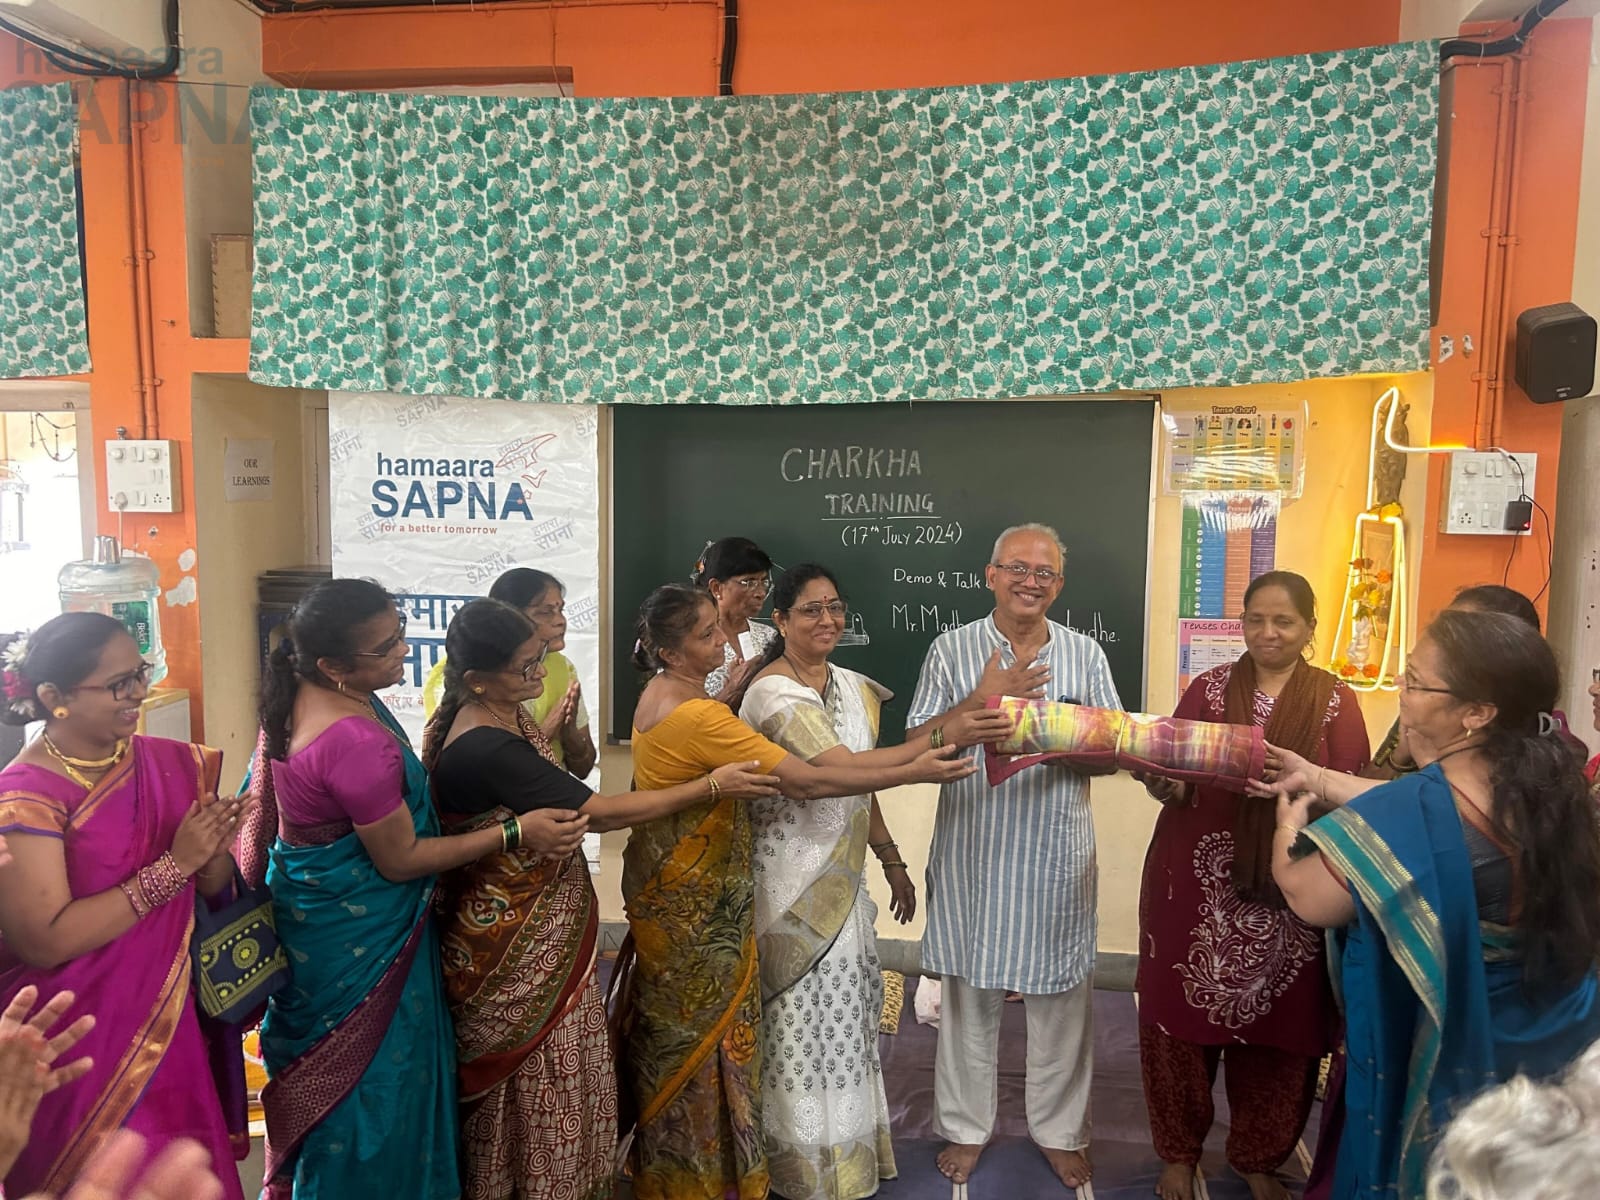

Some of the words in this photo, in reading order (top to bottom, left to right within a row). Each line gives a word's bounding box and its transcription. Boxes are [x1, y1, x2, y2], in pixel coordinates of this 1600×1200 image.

[377, 452, 494, 477] hamaara
[780, 446, 922, 482] CHARKHA
[371, 480, 534, 520] SAPNA
[824, 492, 934, 515] TRAINING
[380, 523, 397, 535] for
[408, 523, 441, 533] better
[444, 524, 498, 534] tomorrow
[914, 521, 963, 545] 2024)
[894, 568, 932, 584] Demo
[937, 571, 947, 588] &
[951, 572, 981, 589] Talk
[1183, 622, 1218, 630] Tenses
